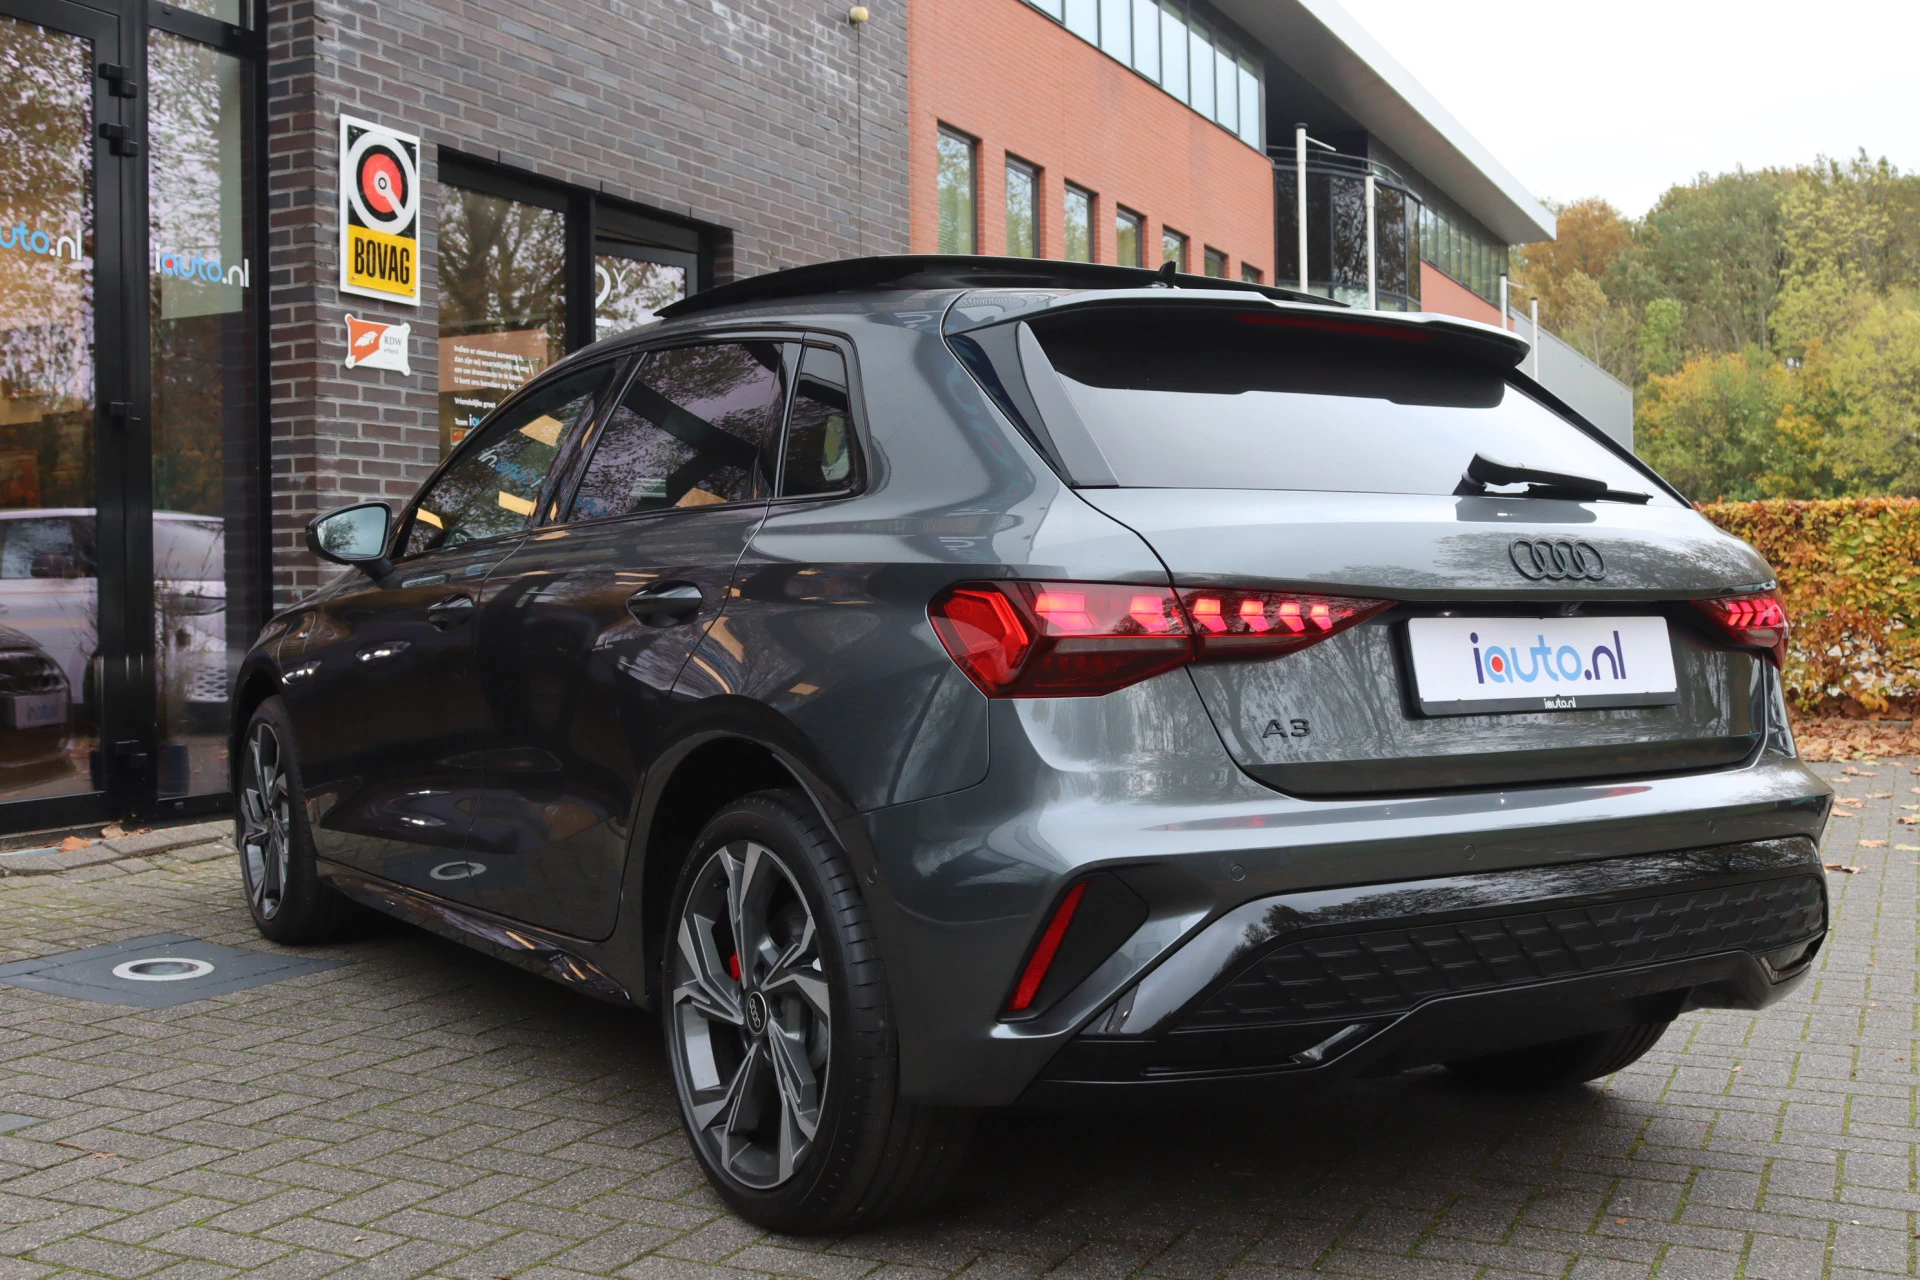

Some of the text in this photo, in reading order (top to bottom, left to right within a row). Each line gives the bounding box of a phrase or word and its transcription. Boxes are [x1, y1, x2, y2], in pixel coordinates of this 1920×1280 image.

[155, 243, 249, 288] iauto.nl
[354, 236, 410, 285] BOVAG
[383, 335, 402, 346] RDW
[454, 417, 468, 426] Team
[1470, 630, 1627, 684] iauto.nl
[1543, 696, 1577, 709] iauto.nl
[1262, 718, 1311, 739] A3
